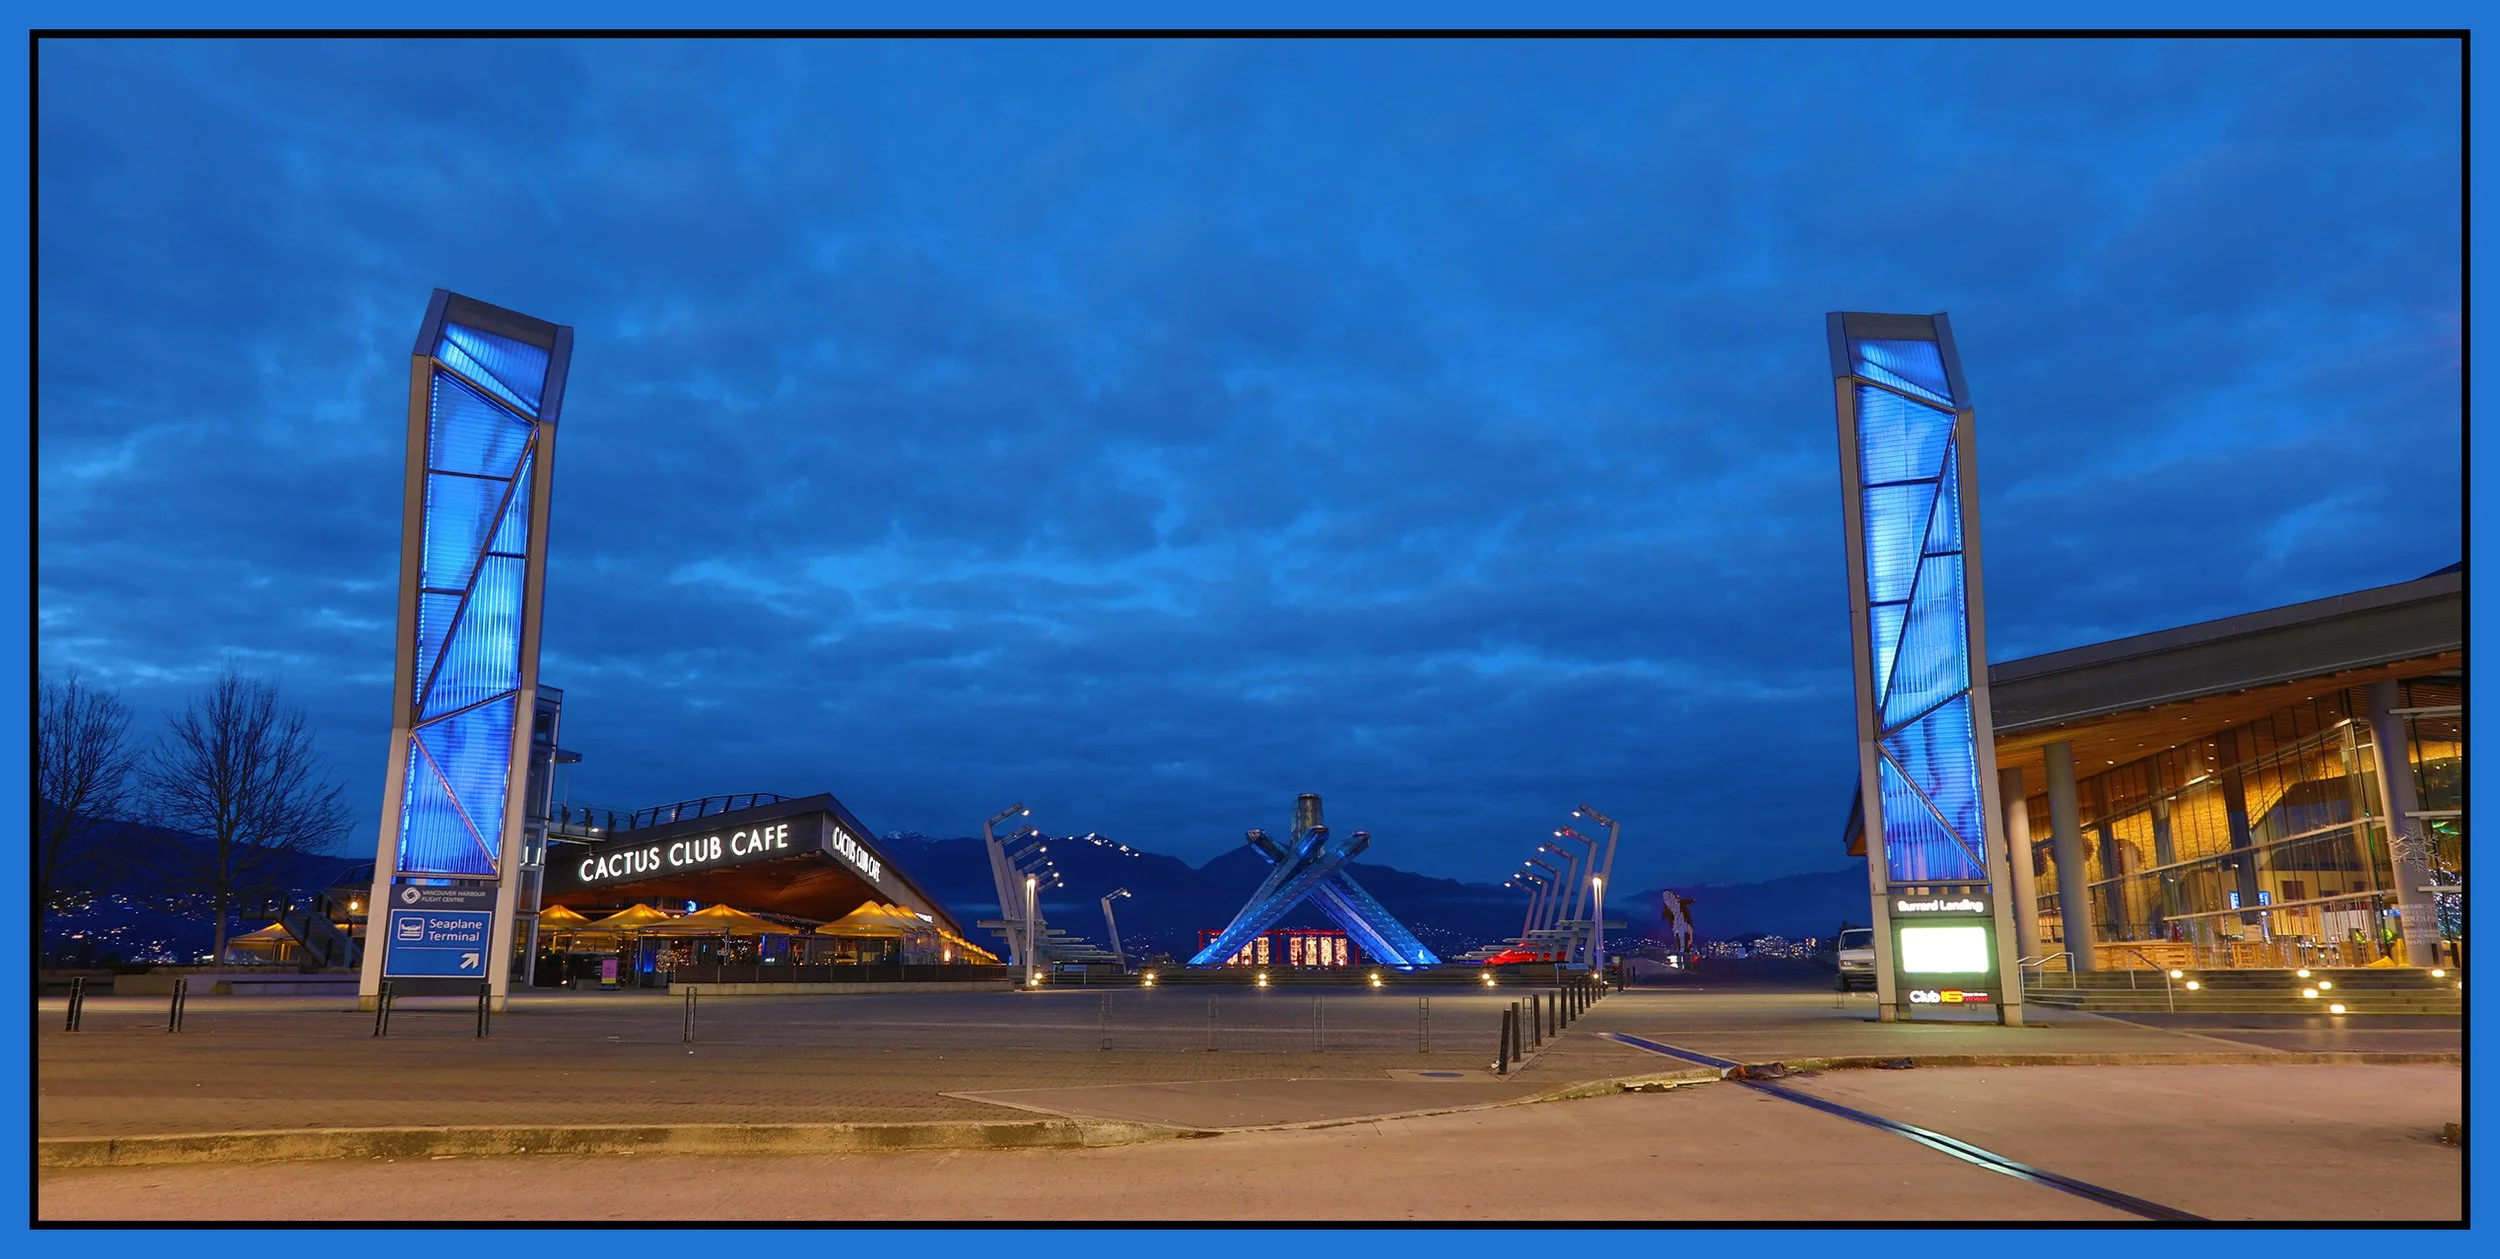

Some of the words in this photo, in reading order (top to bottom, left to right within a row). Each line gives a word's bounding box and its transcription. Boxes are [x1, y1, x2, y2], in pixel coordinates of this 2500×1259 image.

[579, 846, 660, 882] CACTUS
[668, 836, 722, 867] CLUB
[731, 824, 788, 856] CAFE
[1897, 899, 1939, 912] Burrard
[1939, 898, 1984, 913] Landing
[429, 918, 483, 931] Seaplane
[428, 931, 480, 942] Terminal
